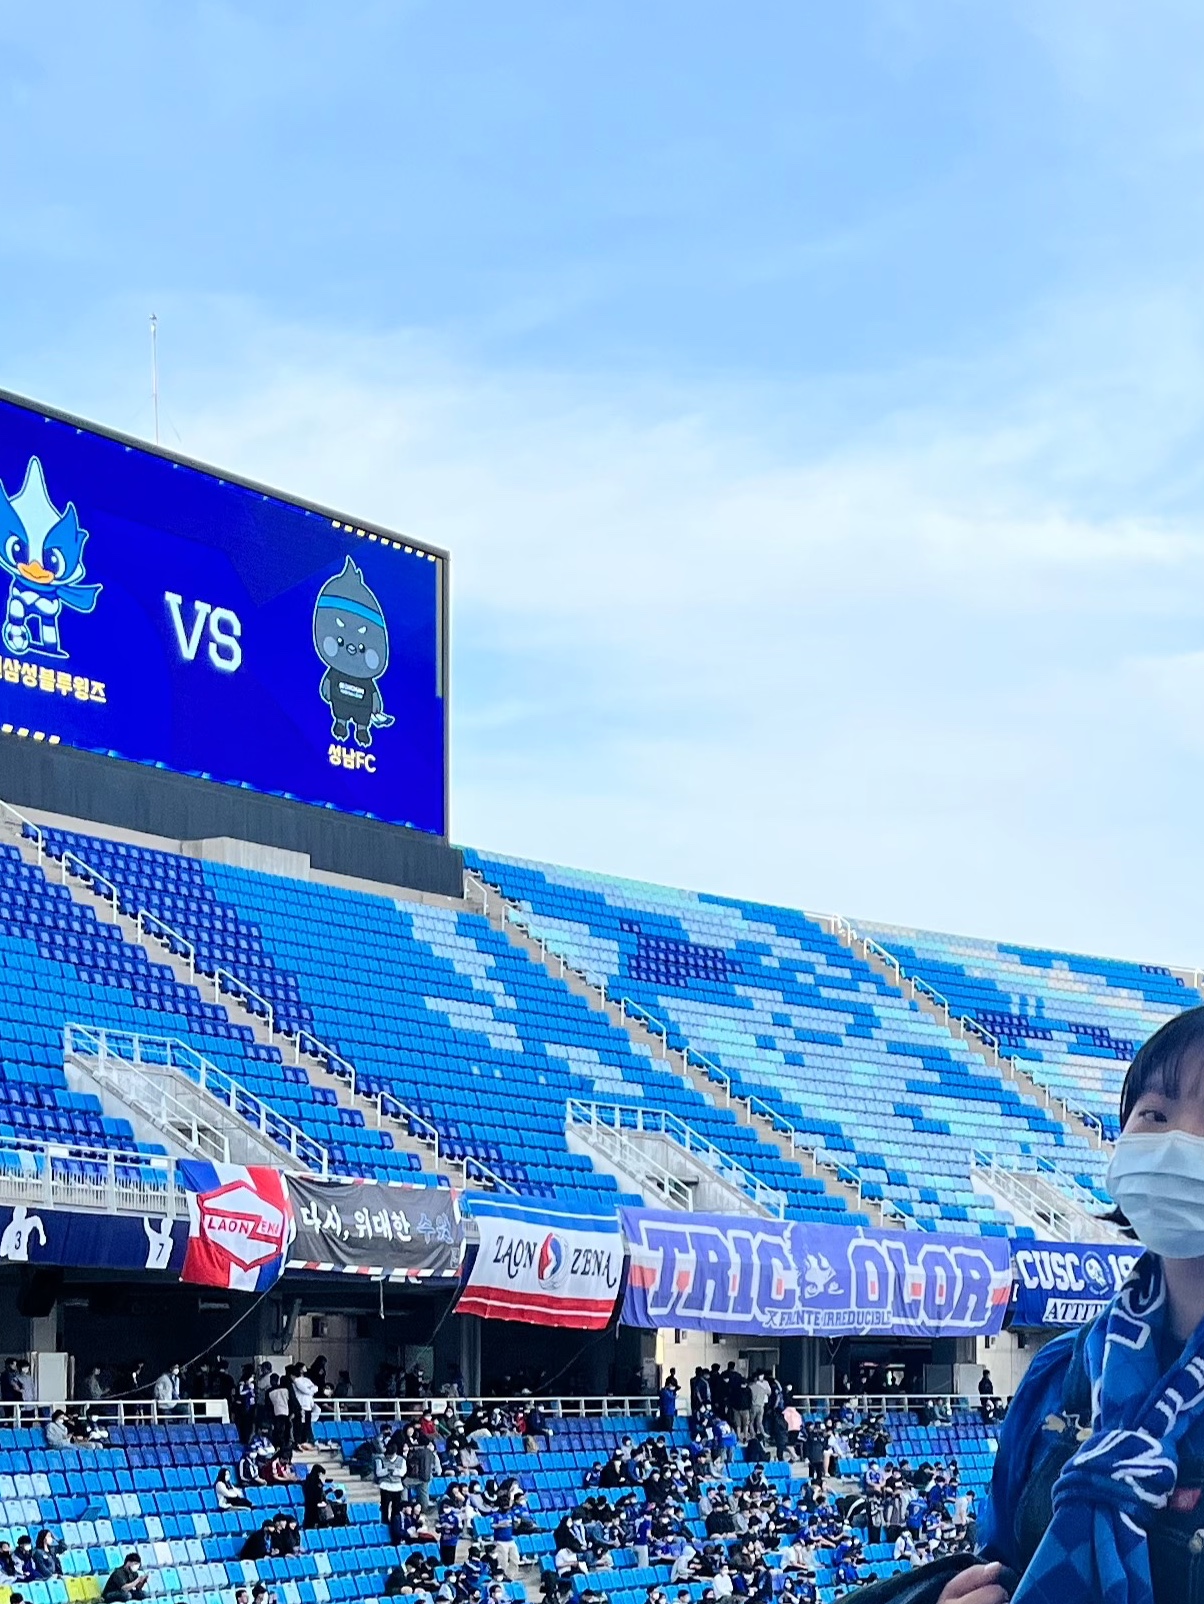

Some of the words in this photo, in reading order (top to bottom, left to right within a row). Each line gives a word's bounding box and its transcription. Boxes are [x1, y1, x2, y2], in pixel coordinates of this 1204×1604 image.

[164, 591, 242, 672] VS
[0, 655, 107, 704] 삼성블루윙즈
[207, 1217, 250, 1235] LAON
[353, 1206, 412, 1243] 위대한
[14, 1230, 22, 1250] 3
[156, 1242, 165, 1262] 7
